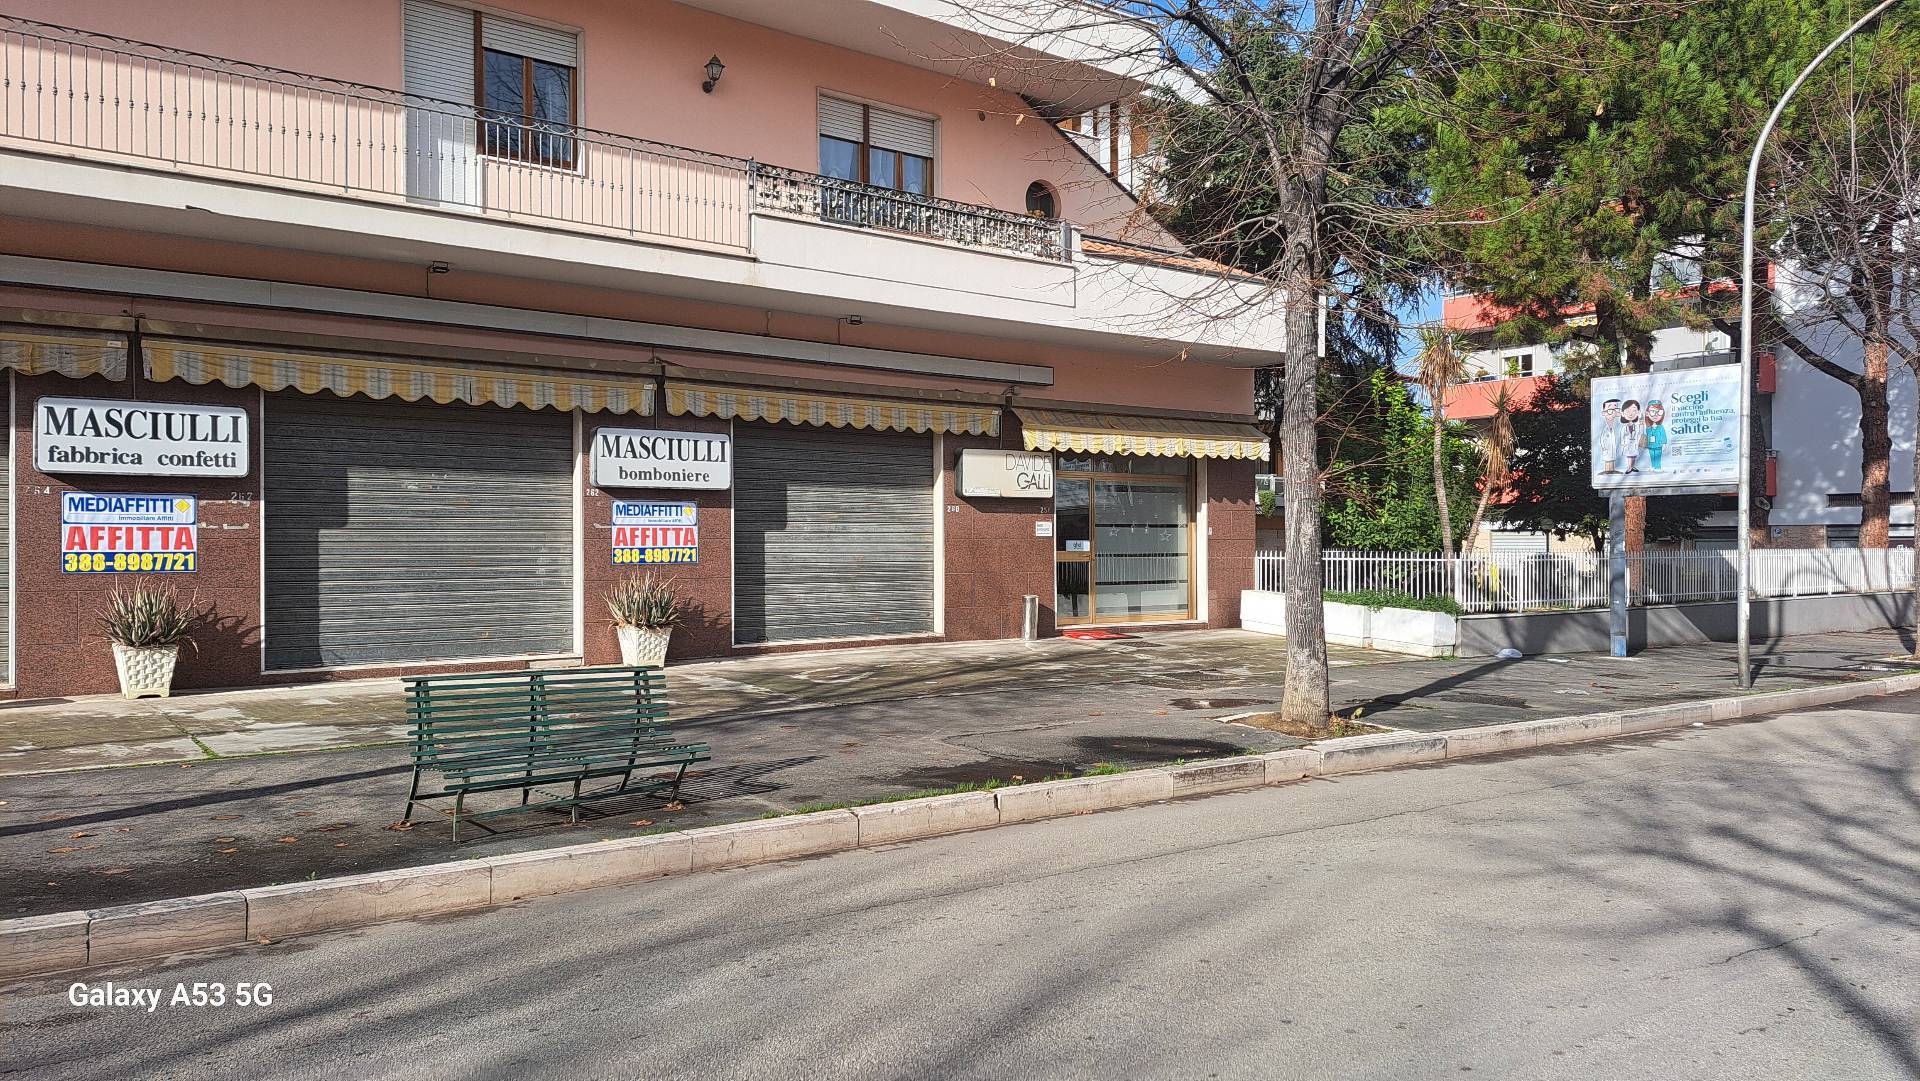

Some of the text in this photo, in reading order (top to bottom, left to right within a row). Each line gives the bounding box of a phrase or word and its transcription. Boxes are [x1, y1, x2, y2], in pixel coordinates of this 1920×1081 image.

[1671, 391, 1708, 404] Scegli
[43, 405, 242, 444] MASCIULLI
[1671, 417, 1701, 425] proteggi
[1671, 423, 1713, 435] salute.
[48, 445, 237, 468] fabbrica confetti
[600, 434, 727, 462] MASCIULLI
[1005, 453, 1051, 472] DAVIDE
[618, 465, 710, 482] bomboniere
[1016, 472, 1051, 490] GALLI
[68, 496, 174, 514] MEDIAFFITTI
[615, 504, 683, 517] MEDIAFFITTI
[65, 526, 195, 551] AFFITTA
[614, 527, 696, 547] AFFITTA
[64, 553, 195, 571] 388-8987721
[614, 548, 697, 563] 388-8987721
